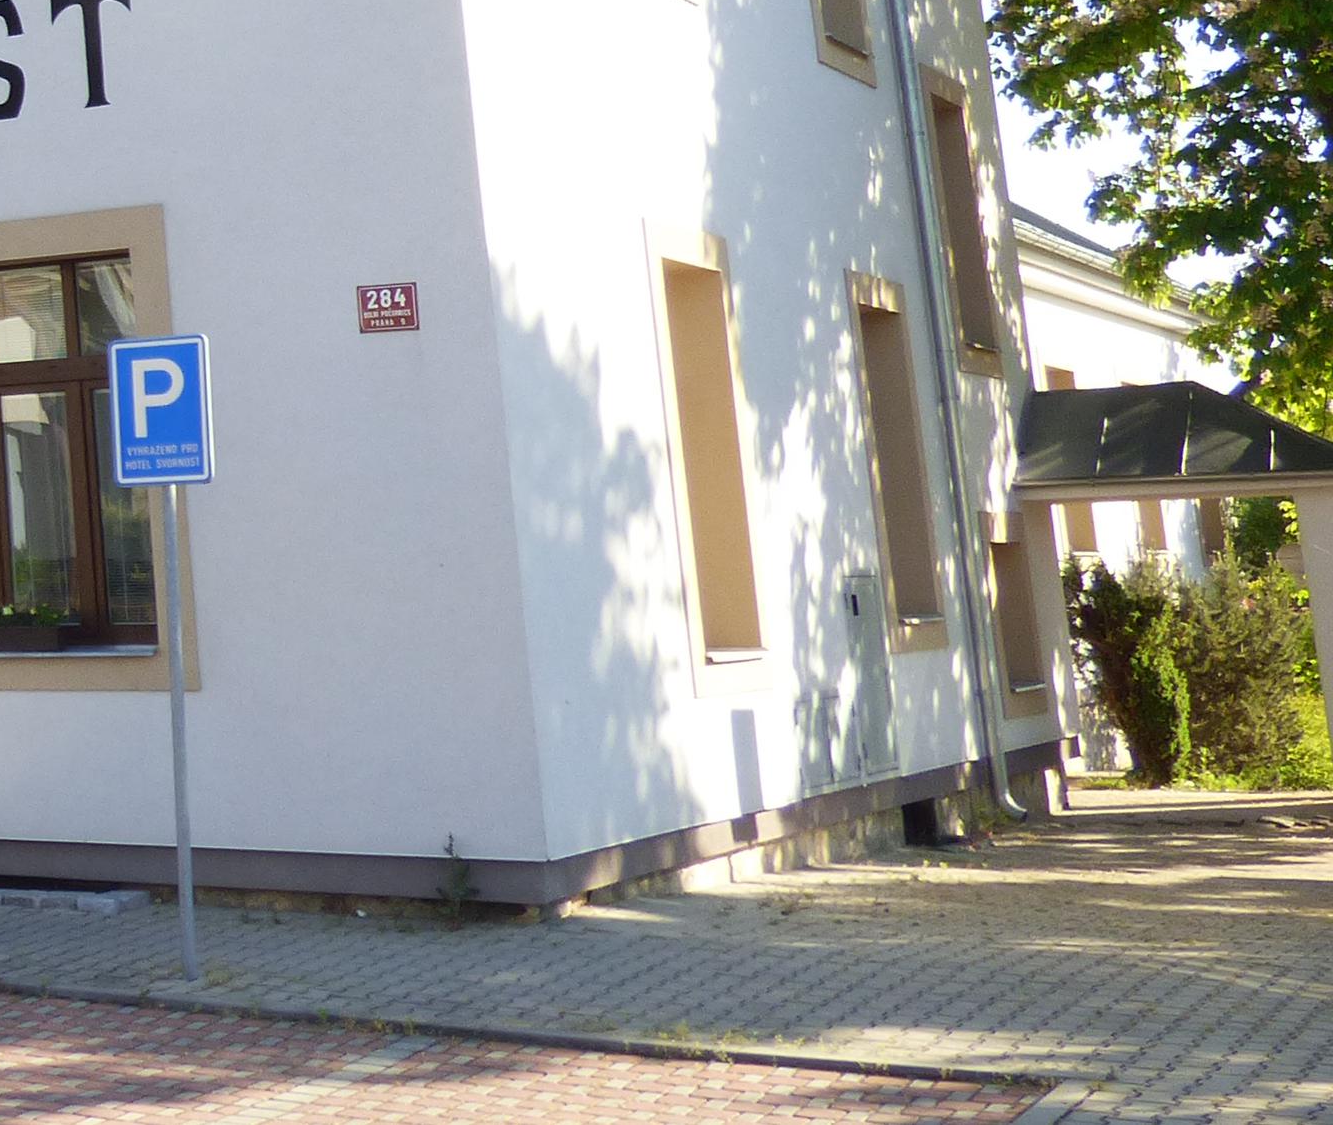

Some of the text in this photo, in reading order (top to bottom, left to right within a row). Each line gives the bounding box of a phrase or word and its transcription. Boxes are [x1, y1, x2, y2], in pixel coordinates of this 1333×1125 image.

[366, 288, 406, 309] 284
[131, 358, 184, 438] P
[181, 443, 198, 454] PRO
[125, 457, 200, 470] HOTEL SVORNOST
